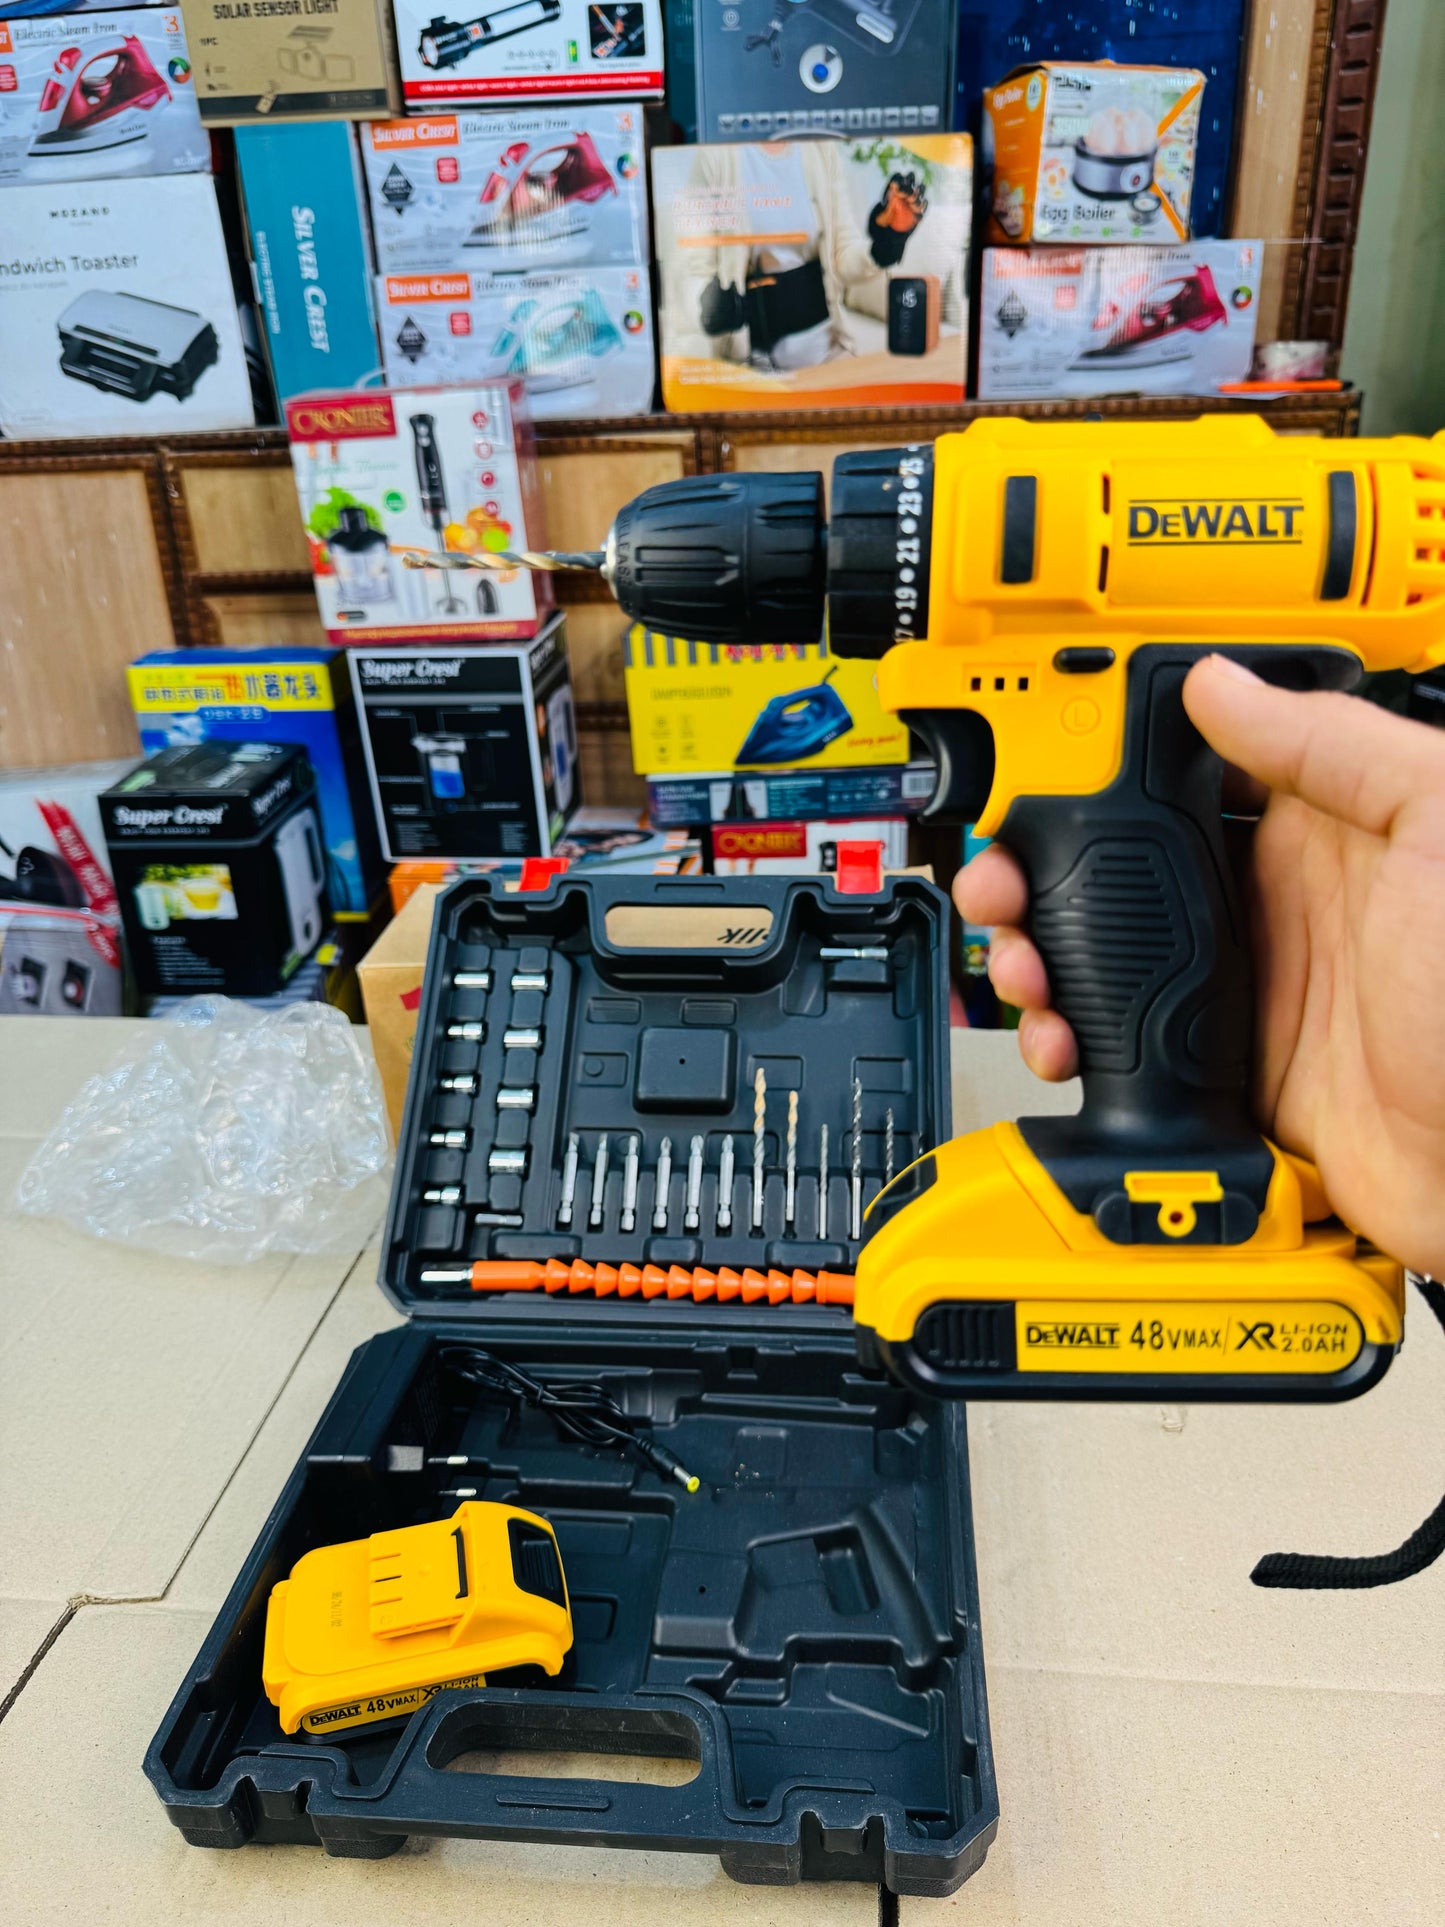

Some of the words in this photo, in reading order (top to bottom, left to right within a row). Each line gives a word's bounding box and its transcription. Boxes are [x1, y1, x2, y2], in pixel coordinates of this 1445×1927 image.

[213, 2, 253, 20] SOLAR
[253, 0, 303, 18] SENSOR
[305, 0, 339, 15] LIGHT
[15, 27, 55, 41] Electric
[59, 24, 90, 36] Steam
[93, 22, 118, 34] Iron
[1041, 203, 1069, 224] Egg
[1073, 202, 1115, 220] Boiler
[70, 253, 139, 272] Toaster
[898, 456, 925, 477] 25
[896, 490, 924, 516] 23
[896, 536, 921, 565] 21
[894, 585, 919, 611] 19
[113, 804, 173, 829] Super
[1235, 1321, 1277, 1351] XR
[1279, 1323, 1349, 1336] LI-ION
[1282, 1336, 1347, 1353] 2.0AH
